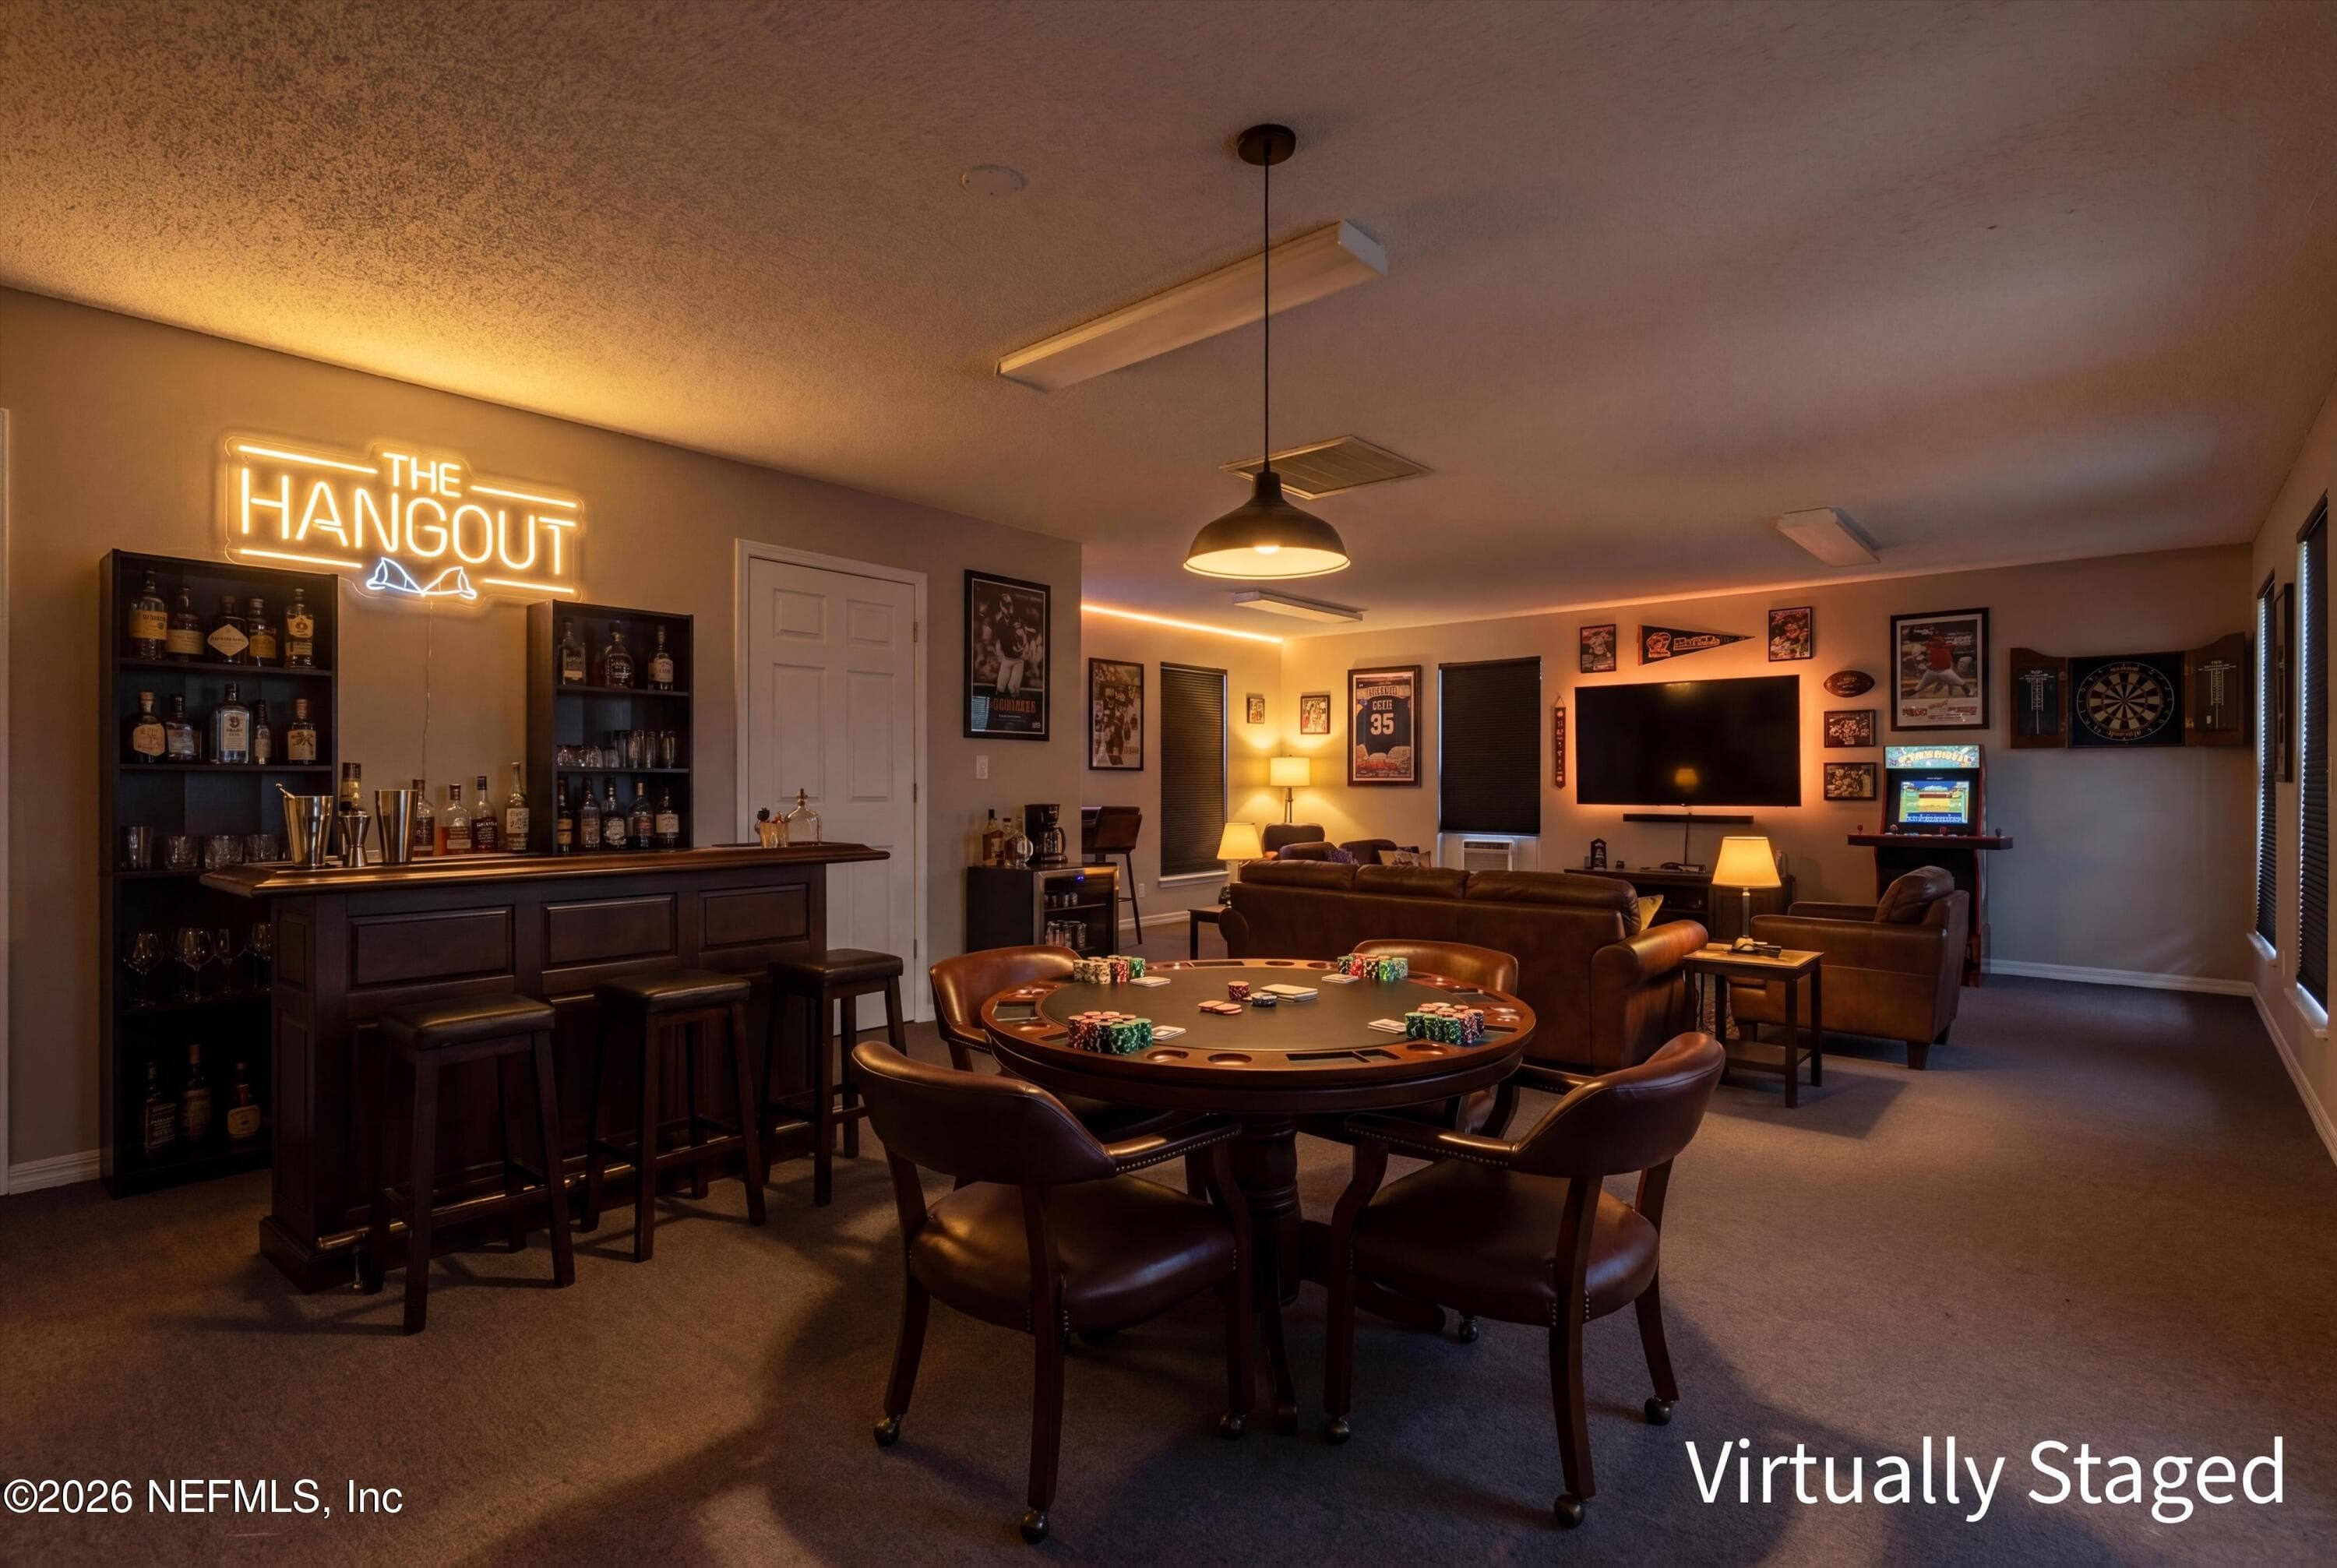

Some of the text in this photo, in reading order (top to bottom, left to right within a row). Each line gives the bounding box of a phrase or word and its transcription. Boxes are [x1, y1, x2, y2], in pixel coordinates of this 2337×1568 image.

[382, 452, 462, 499] THE
[240, 467, 576, 576] HANGOUT
[1370, 712, 1394, 735] 35
